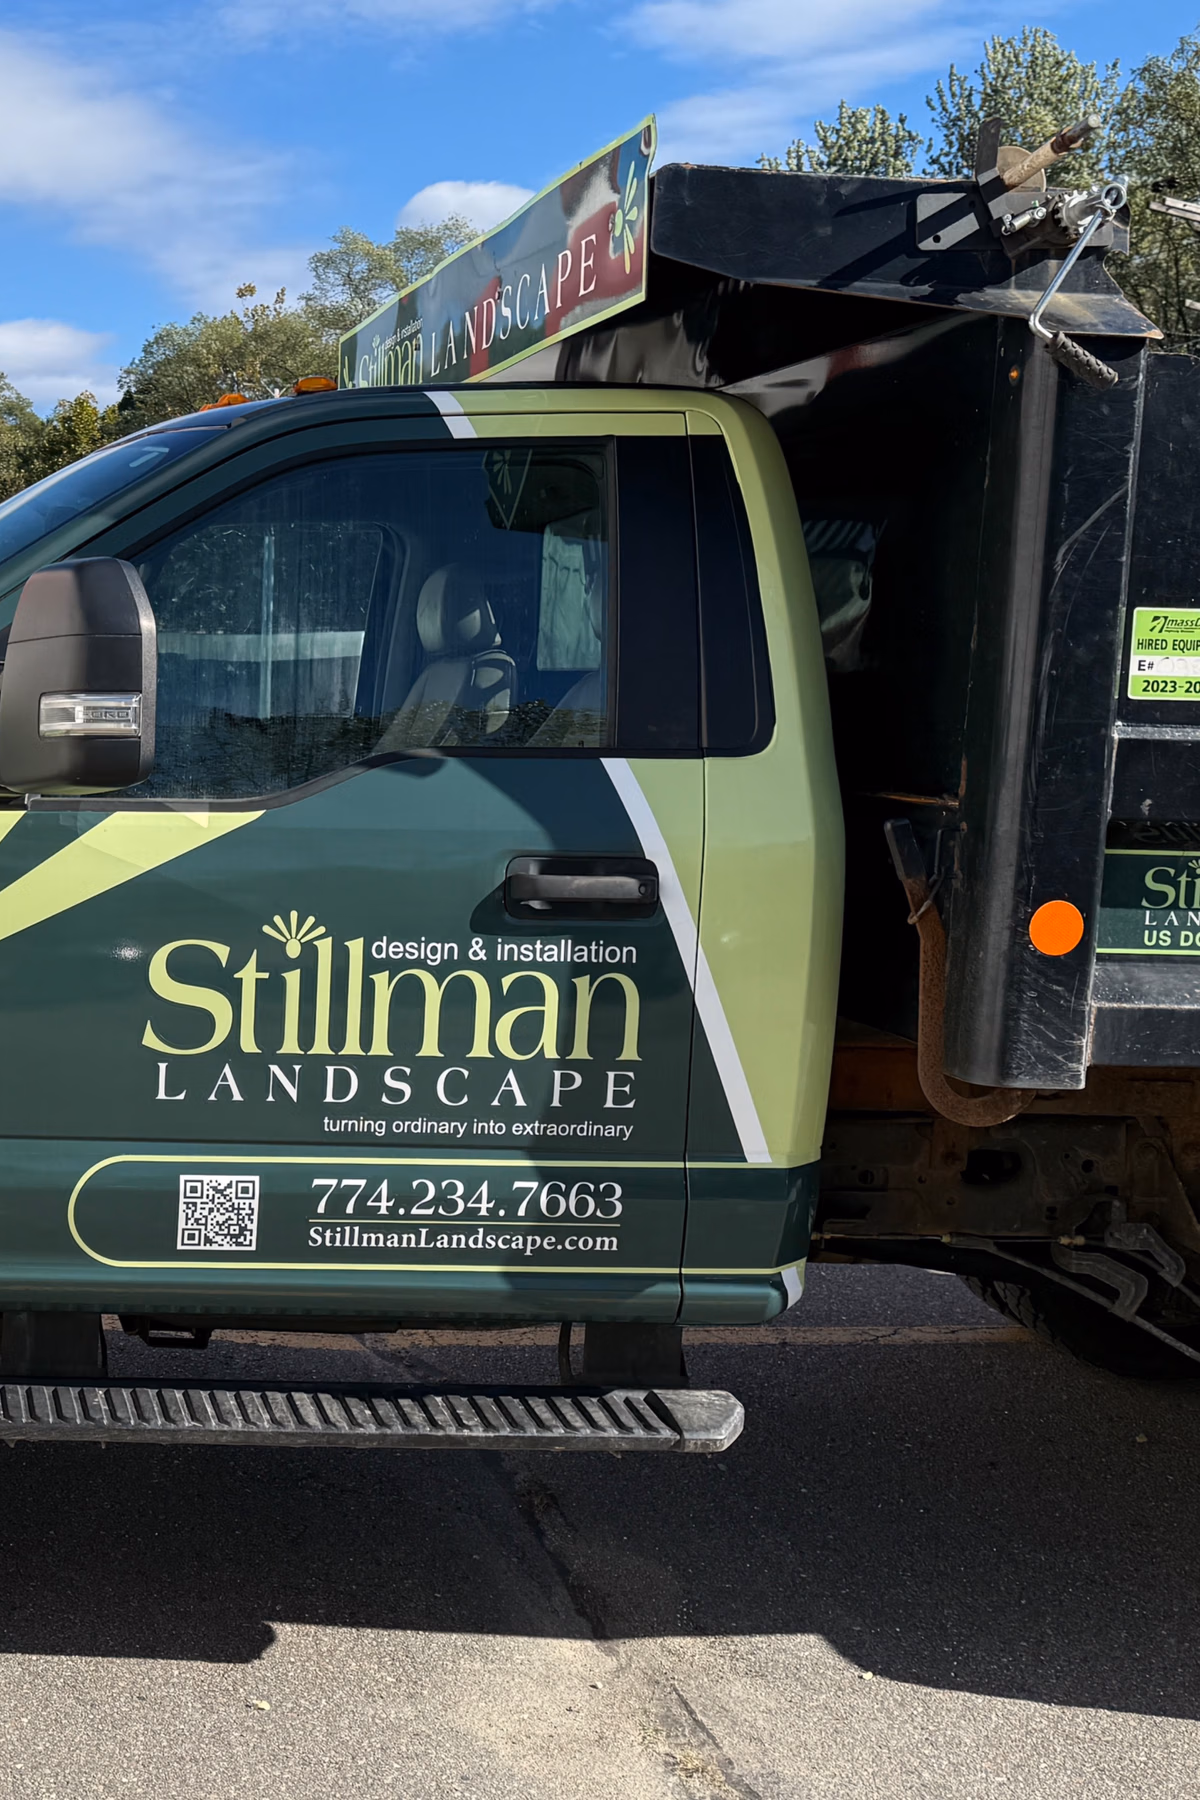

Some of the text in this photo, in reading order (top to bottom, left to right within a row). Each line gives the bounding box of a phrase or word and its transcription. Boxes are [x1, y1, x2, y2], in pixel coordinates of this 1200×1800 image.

[359, 234, 597, 388] Stillman LANDSCAPE
[1137, 638, 1168, 650] HIRED
[1138, 660, 1154, 671] E#
[1142, 680, 1200, 693] 2023-20
[1144, 910, 1200, 926] LAN
[371, 936, 637, 965] design & installation
[1144, 930, 1172, 946] US
[141, 936, 643, 1061] Stillman
[155, 1063, 636, 1109] LANDSCAPE
[323, 1116, 634, 1141] turning ordinary into extraordinary
[310, 1178, 624, 1219] 774.234.7663
[308, 1226, 619, 1256] StillmanLandscape.com
